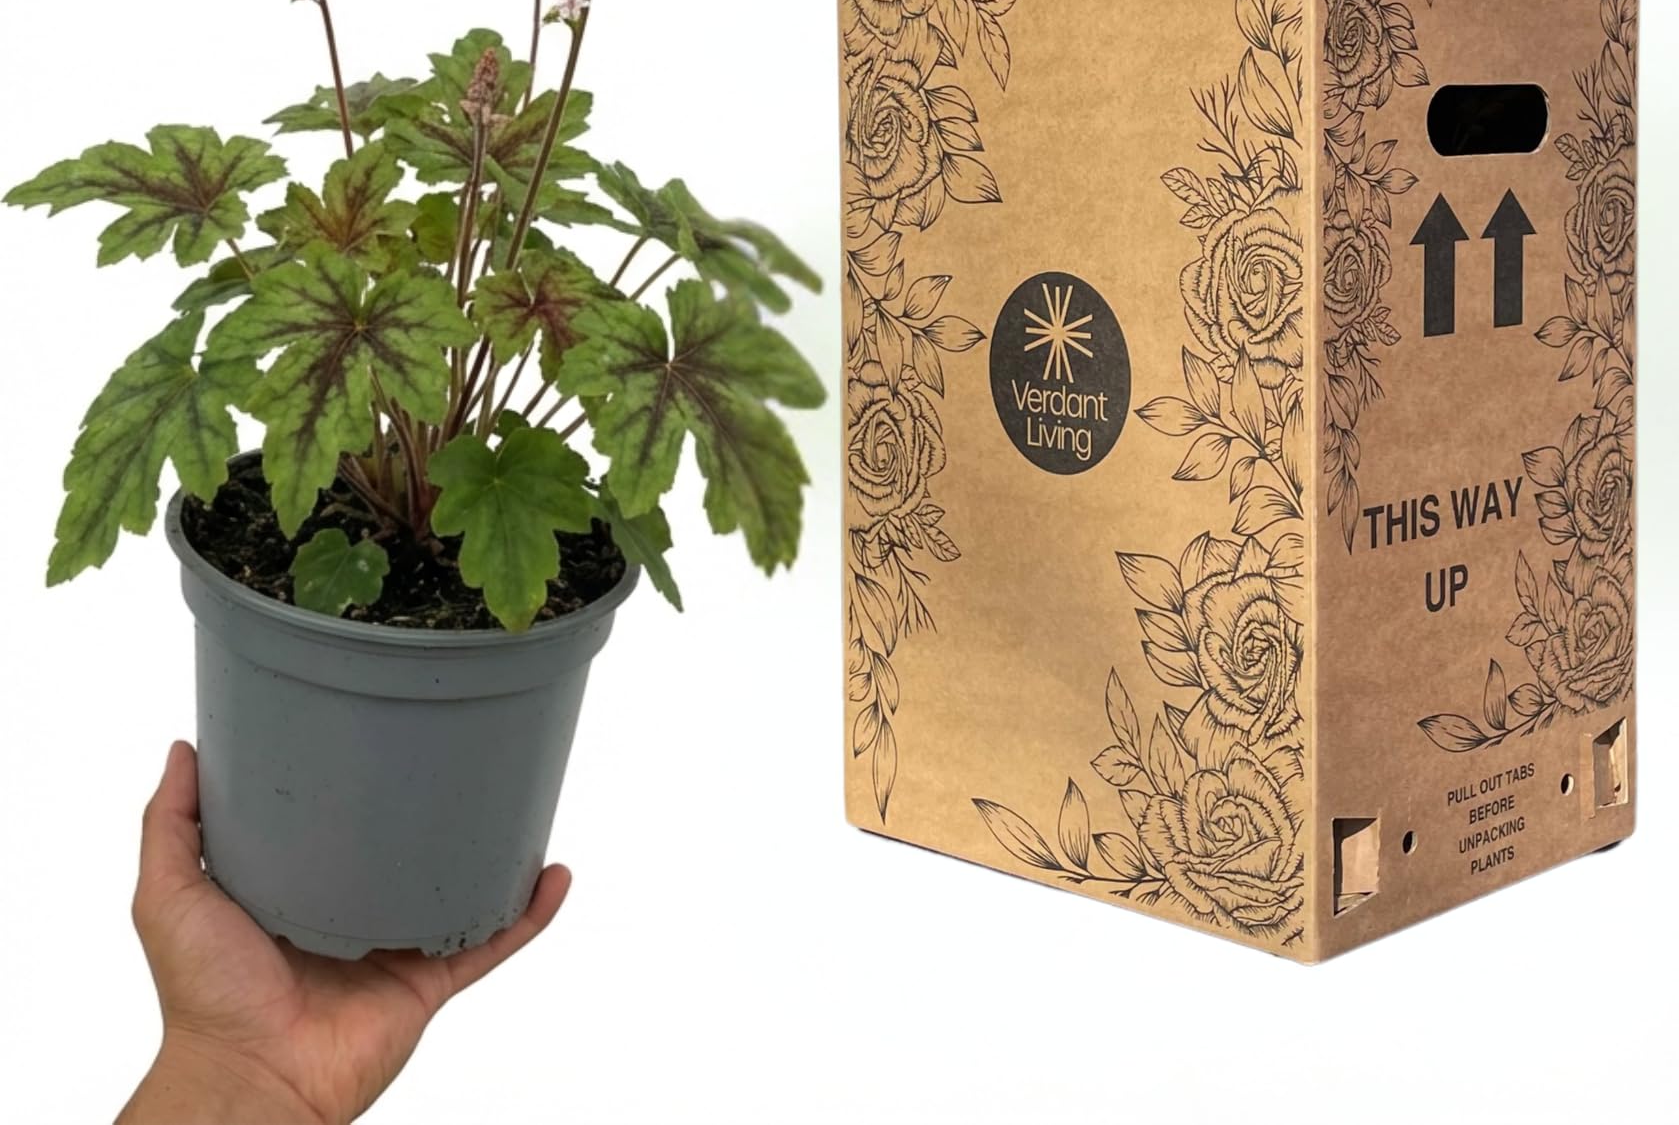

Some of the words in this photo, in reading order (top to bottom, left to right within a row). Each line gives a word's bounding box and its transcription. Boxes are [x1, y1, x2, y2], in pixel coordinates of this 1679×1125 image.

[1011, 378, 1109, 422] Verdant
[1026, 416, 1092, 461] Living
[1363, 494, 1440, 549] THIS
[1450, 476, 1523, 530] WAY
[1425, 564, 1469, 613] UP
[1447, 784, 1477, 806] PULL
[1479, 774, 1503, 794] OUT
[1505, 763, 1535, 785] TABS
[1469, 795, 1515, 825] BEFORE
[1458, 816, 1526, 854] UNPACKING
[1470, 845, 1515, 875] PLANTS
